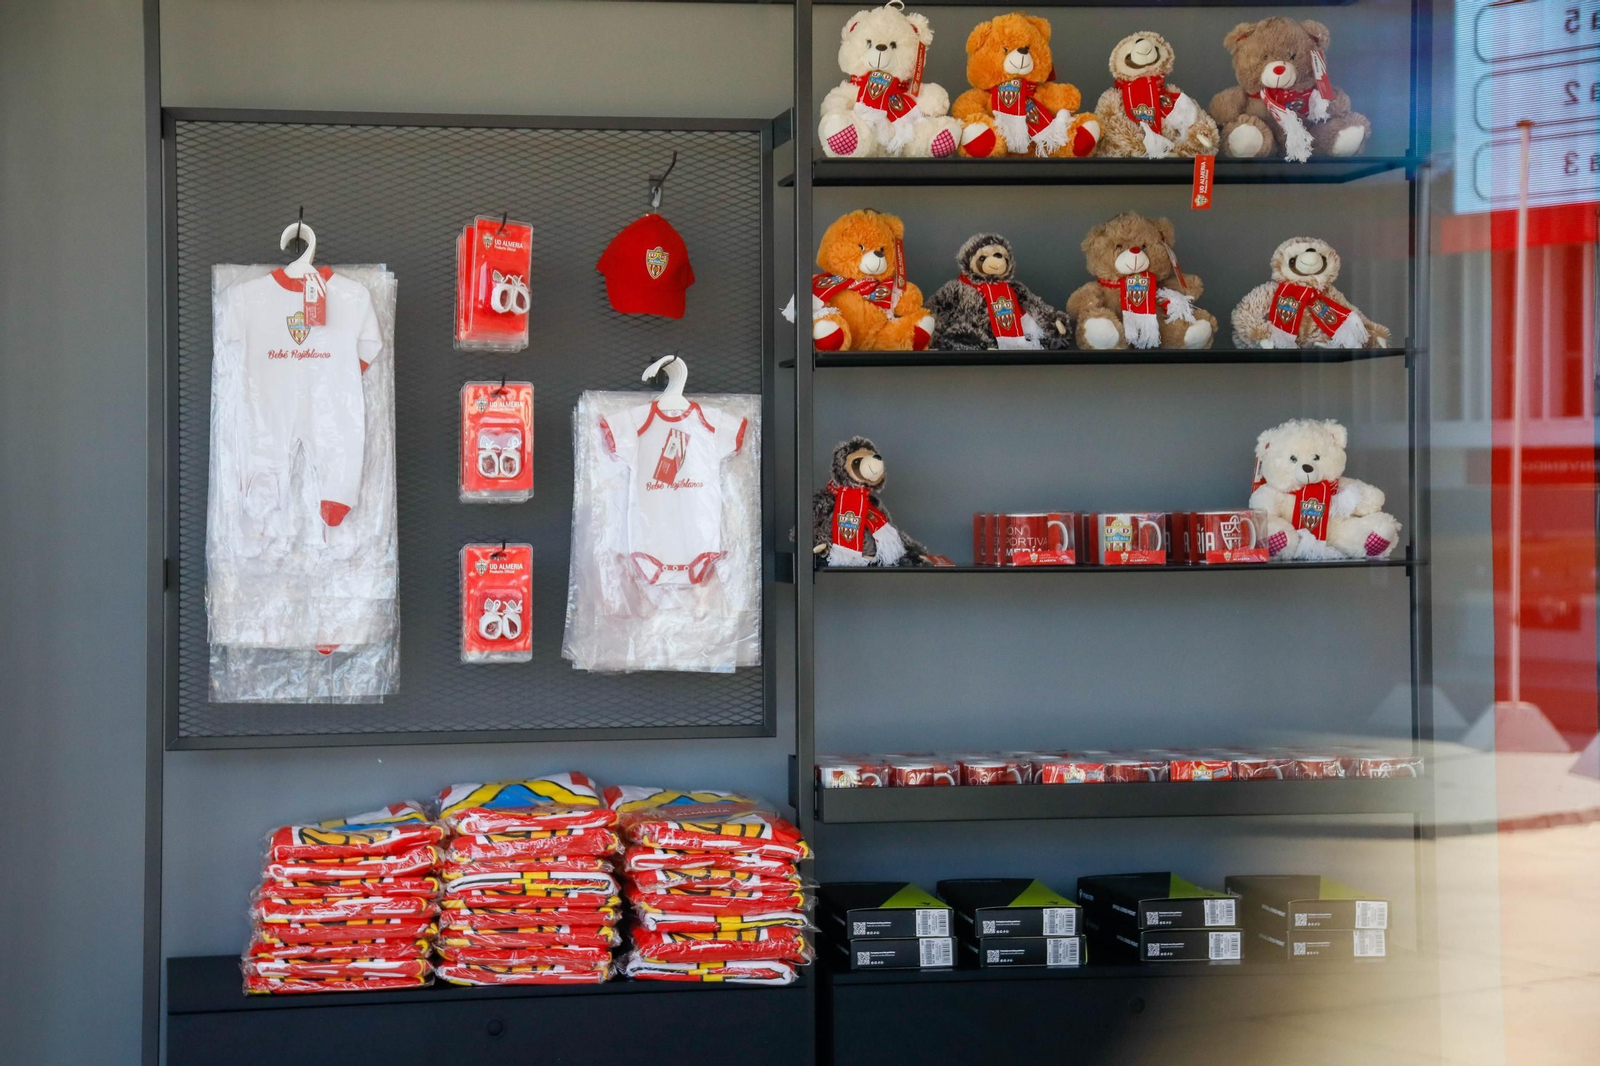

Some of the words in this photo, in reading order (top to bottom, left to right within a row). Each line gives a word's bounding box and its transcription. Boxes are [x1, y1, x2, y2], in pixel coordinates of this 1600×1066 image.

[495, 238, 502, 246] UD
[502, 240, 524, 249] ALMERIA
[267, 350, 288, 359] Bebé
[290, 349, 331, 360] Rojiblanco
